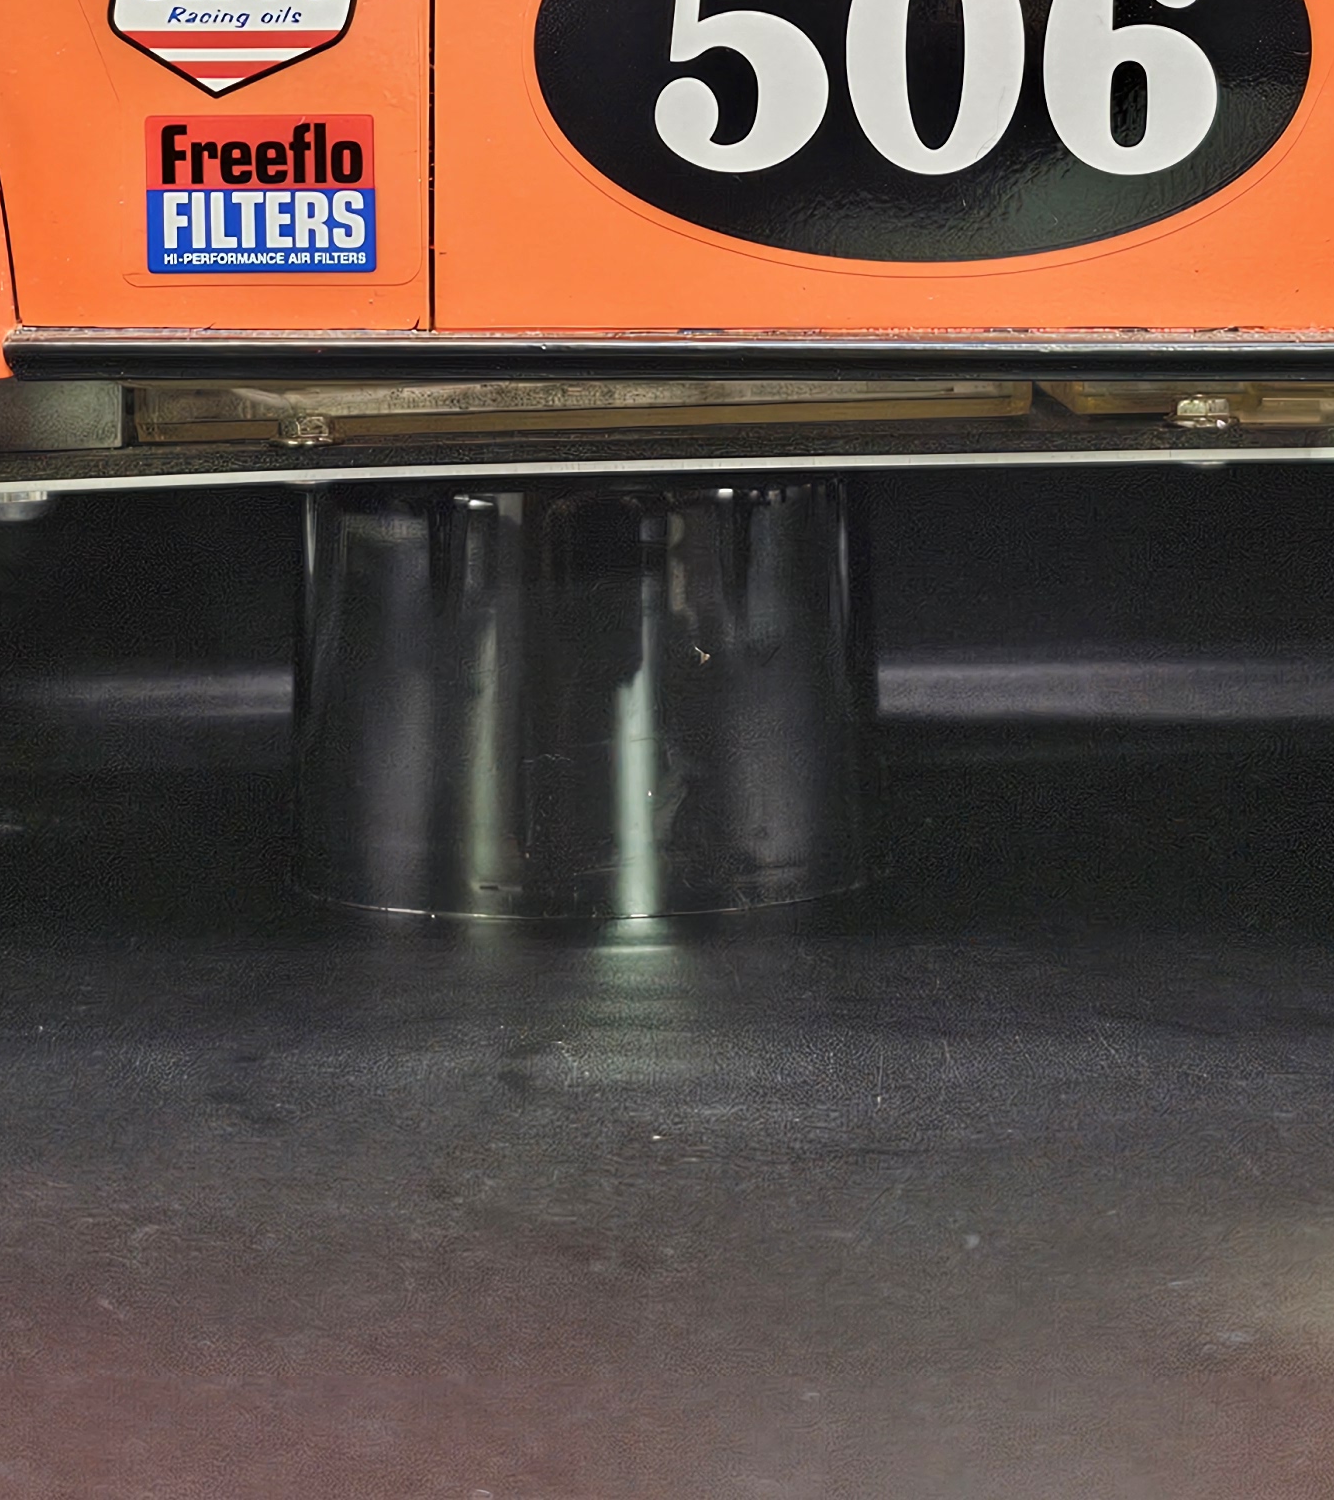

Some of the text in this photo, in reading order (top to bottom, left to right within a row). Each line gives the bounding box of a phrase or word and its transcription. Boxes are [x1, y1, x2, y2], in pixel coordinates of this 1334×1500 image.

[167, 6, 302, 28] Racing oils
[161, 122, 364, 184] Freeflo
[163, 190, 366, 249] FILTERS
[164, 252, 366, 265] HI-PERFORMANCE AIR FILTERS
